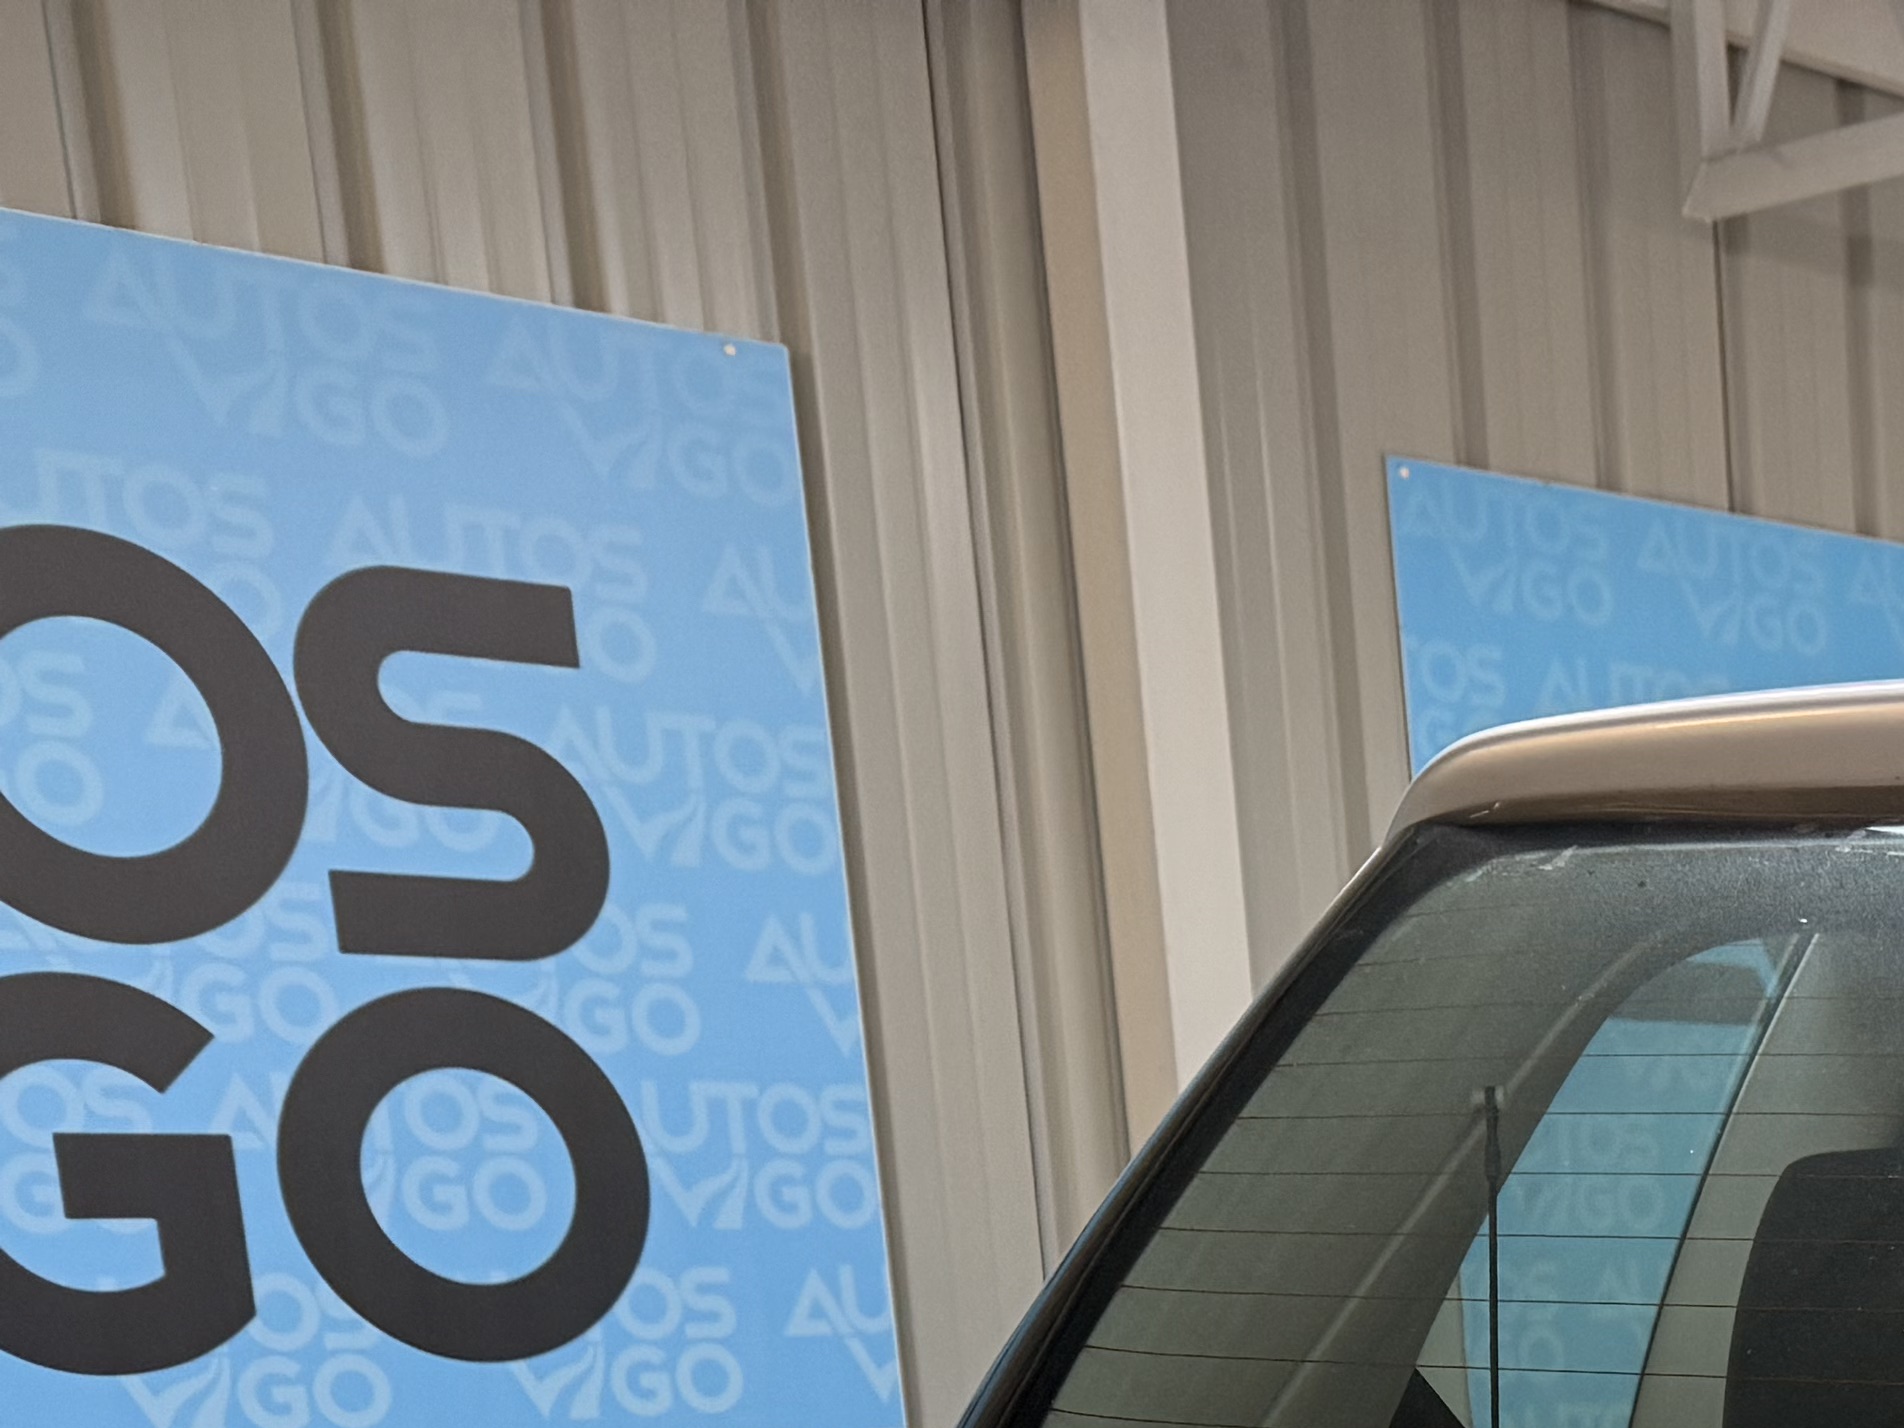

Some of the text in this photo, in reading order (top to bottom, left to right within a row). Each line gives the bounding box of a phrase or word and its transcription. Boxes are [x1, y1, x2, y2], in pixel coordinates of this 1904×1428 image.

[83, 240, 441, 373] AUTOS
[165, 325, 450, 459] VIGO
[1401, 478, 1608, 562] AUTOS
[1637, 512, 1825, 597] AUTOS
[1446, 541, 1614, 627] VIGO
[1676, 575, 1828, 656] VIGO
[603, 784, 838, 875] VIGO
